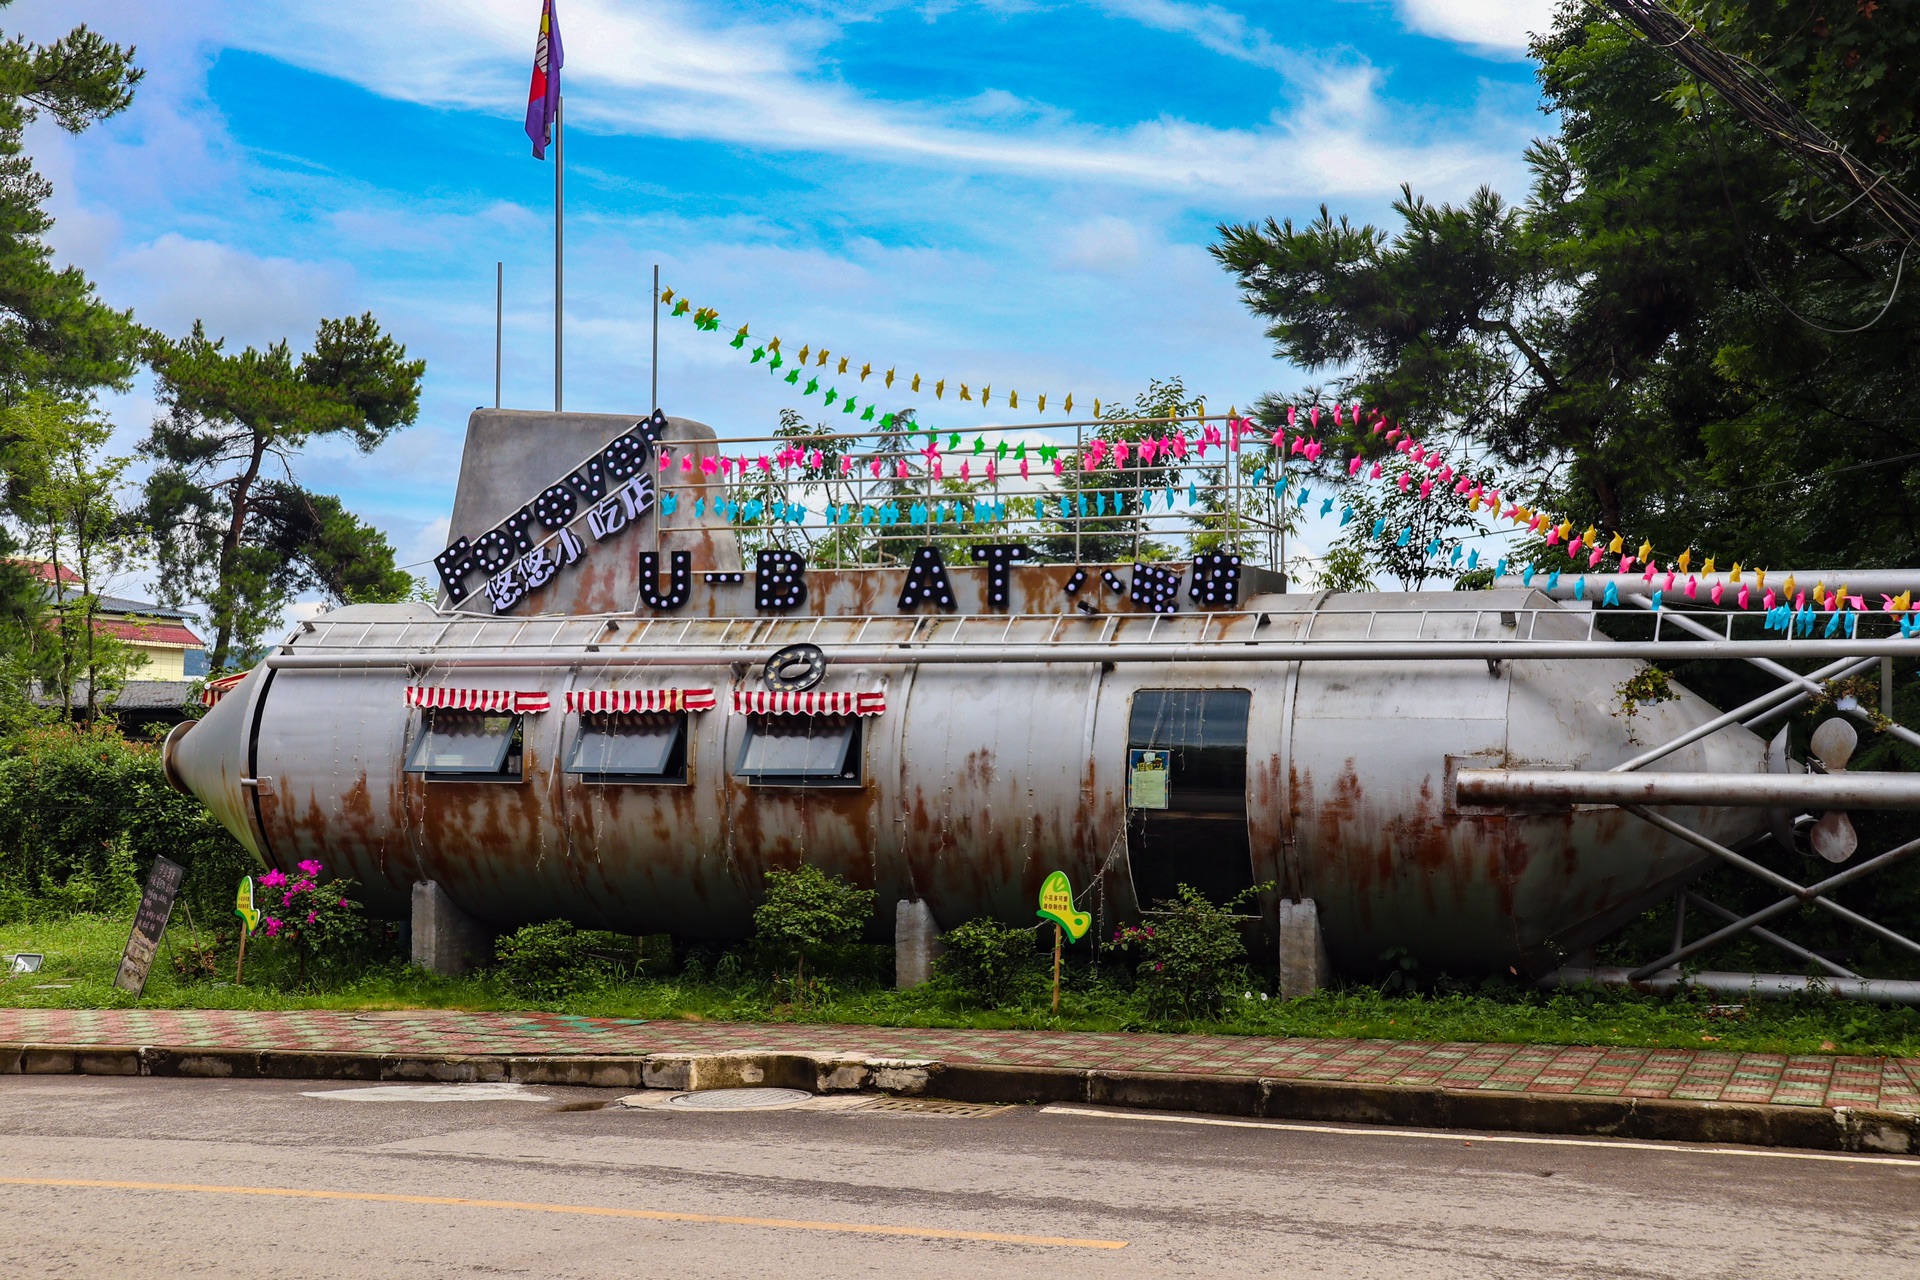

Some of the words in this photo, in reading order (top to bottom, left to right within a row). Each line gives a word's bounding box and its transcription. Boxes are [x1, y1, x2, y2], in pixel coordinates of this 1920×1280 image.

[434, 408, 669, 604] Forever
[484, 472, 656, 614] 悠悠小吃店
